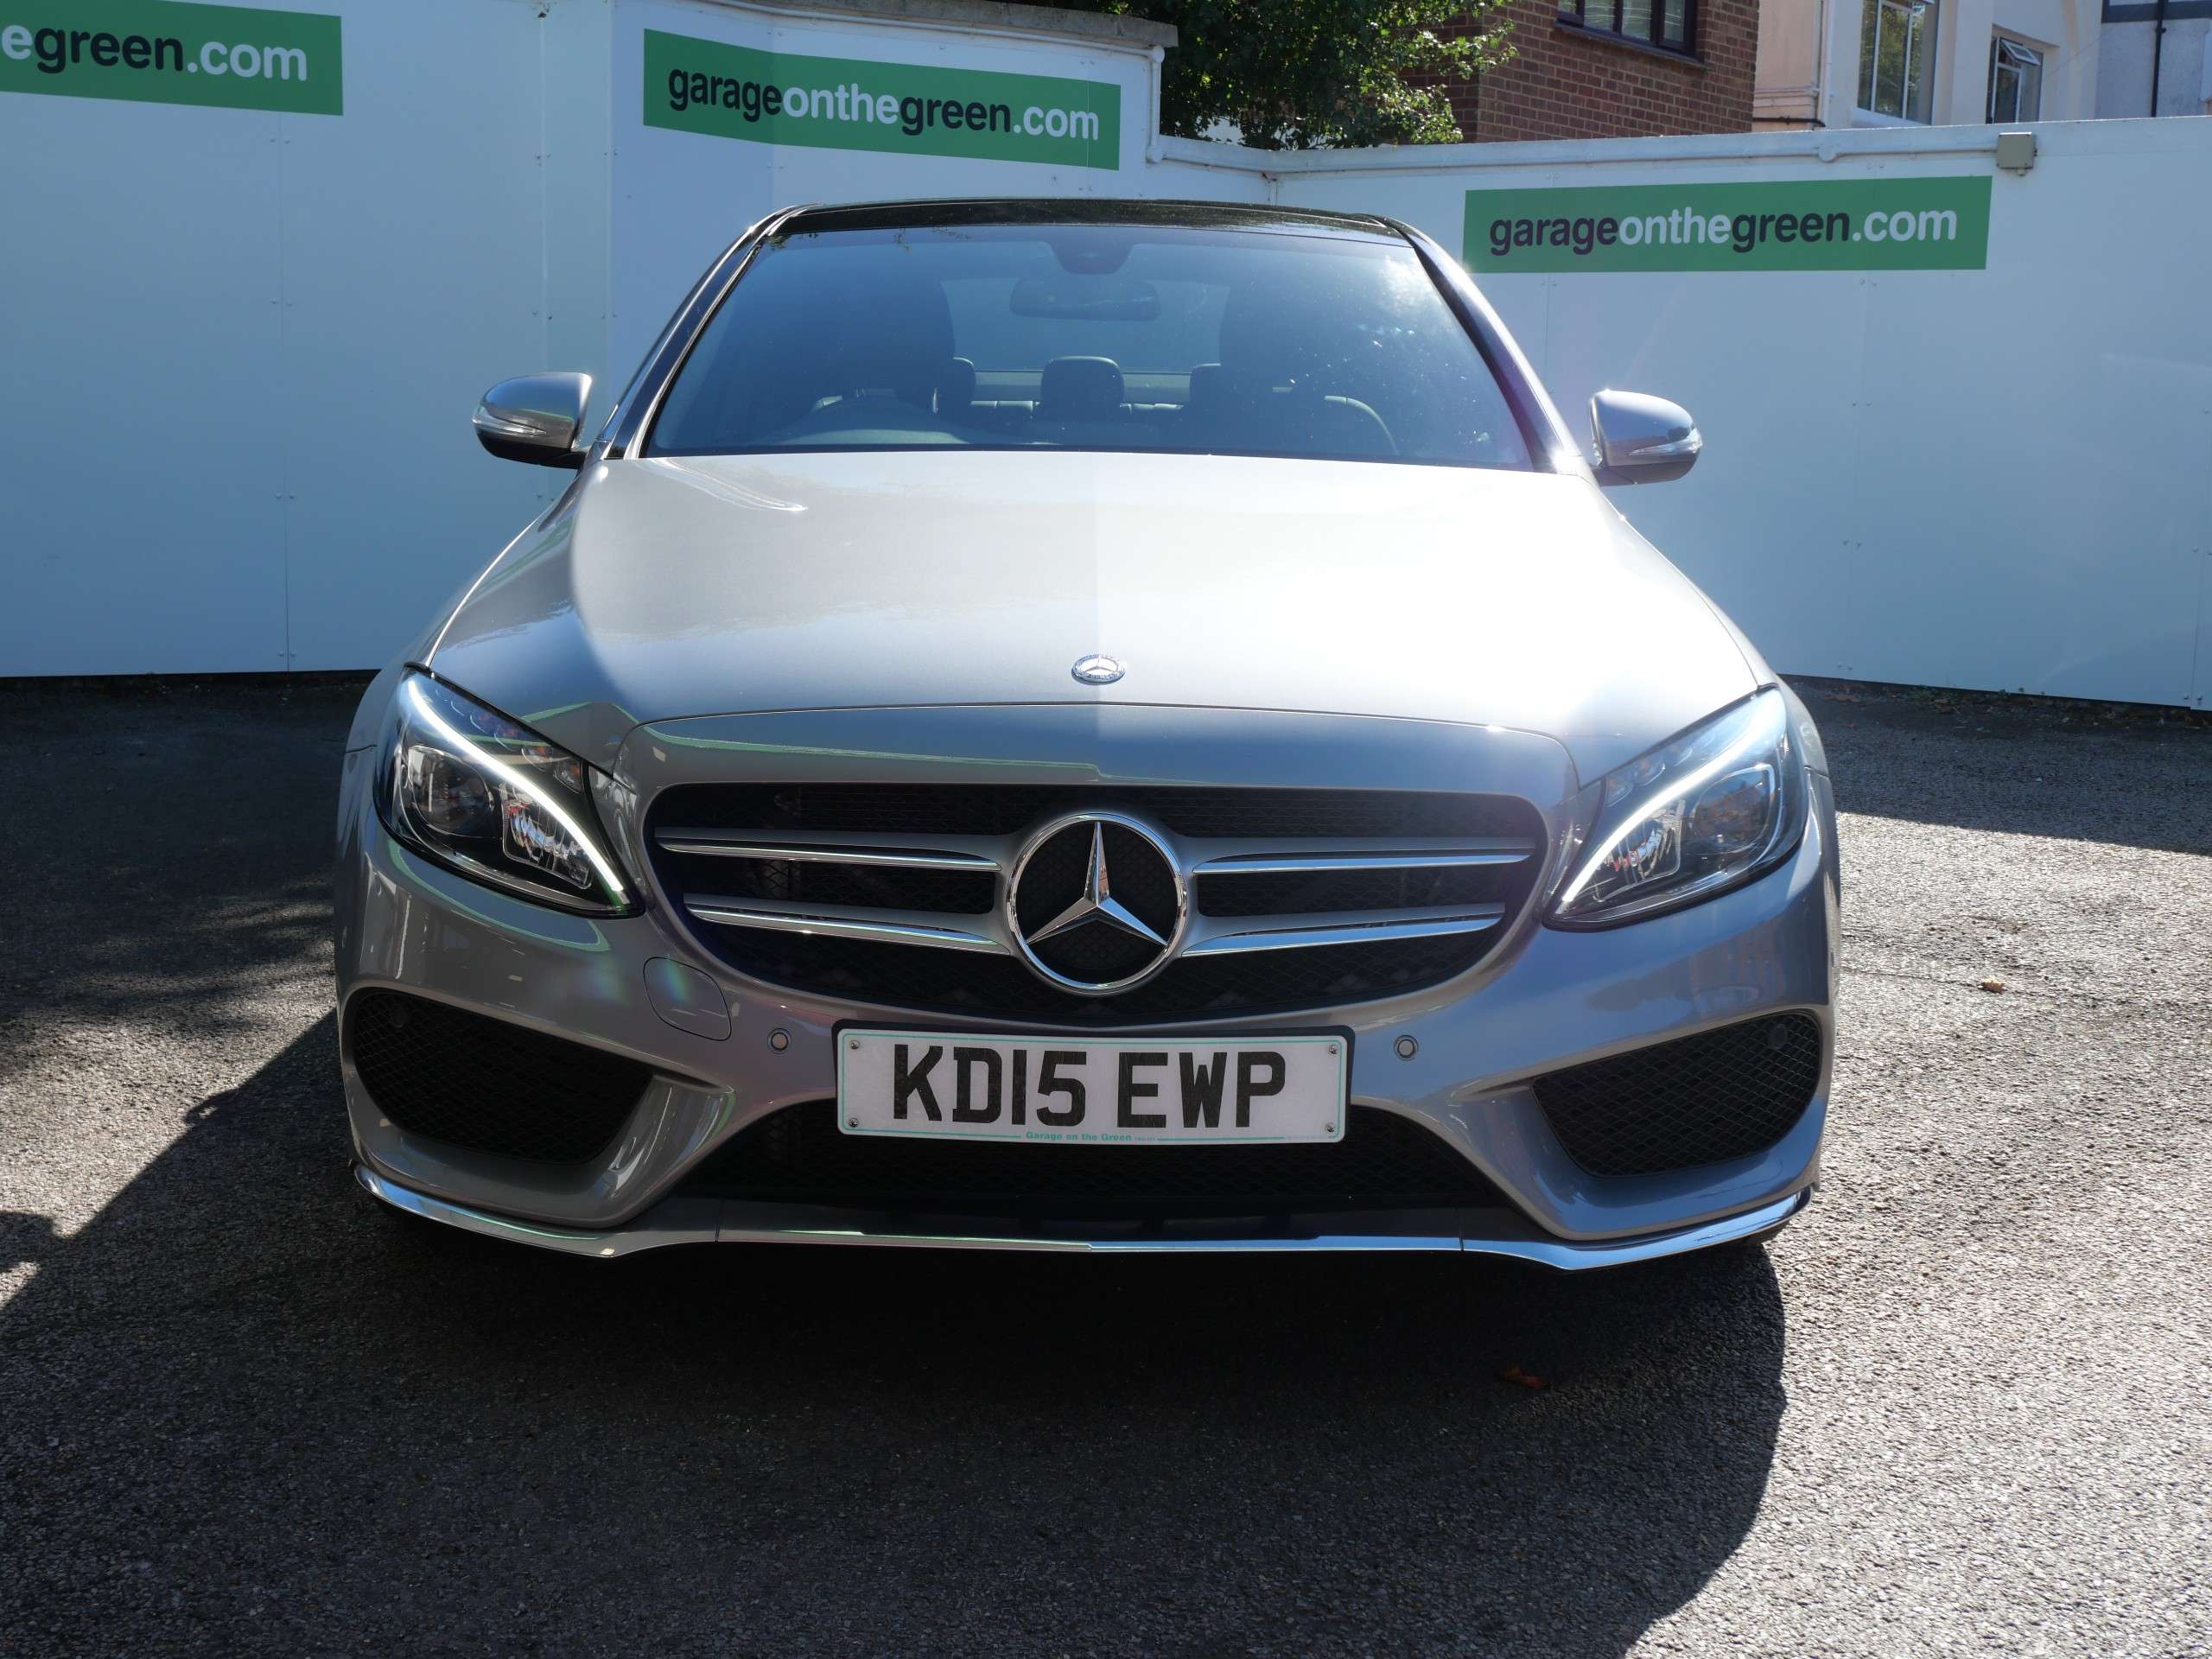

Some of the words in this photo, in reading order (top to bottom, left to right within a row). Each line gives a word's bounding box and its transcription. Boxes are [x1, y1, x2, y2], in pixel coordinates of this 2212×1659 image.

[669, 68, 1100, 141] garageonthegreen.com
[1490, 206, 1957, 257] garageonthegreen.com
[893, 1044, 1087, 1127] KD15
[1117, 1052, 1286, 1128] EWP
[1026, 1131, 1063, 1141] Garage
[1081, 1132, 1097, 1141] the
[1101, 1133, 1132, 1141] Green
